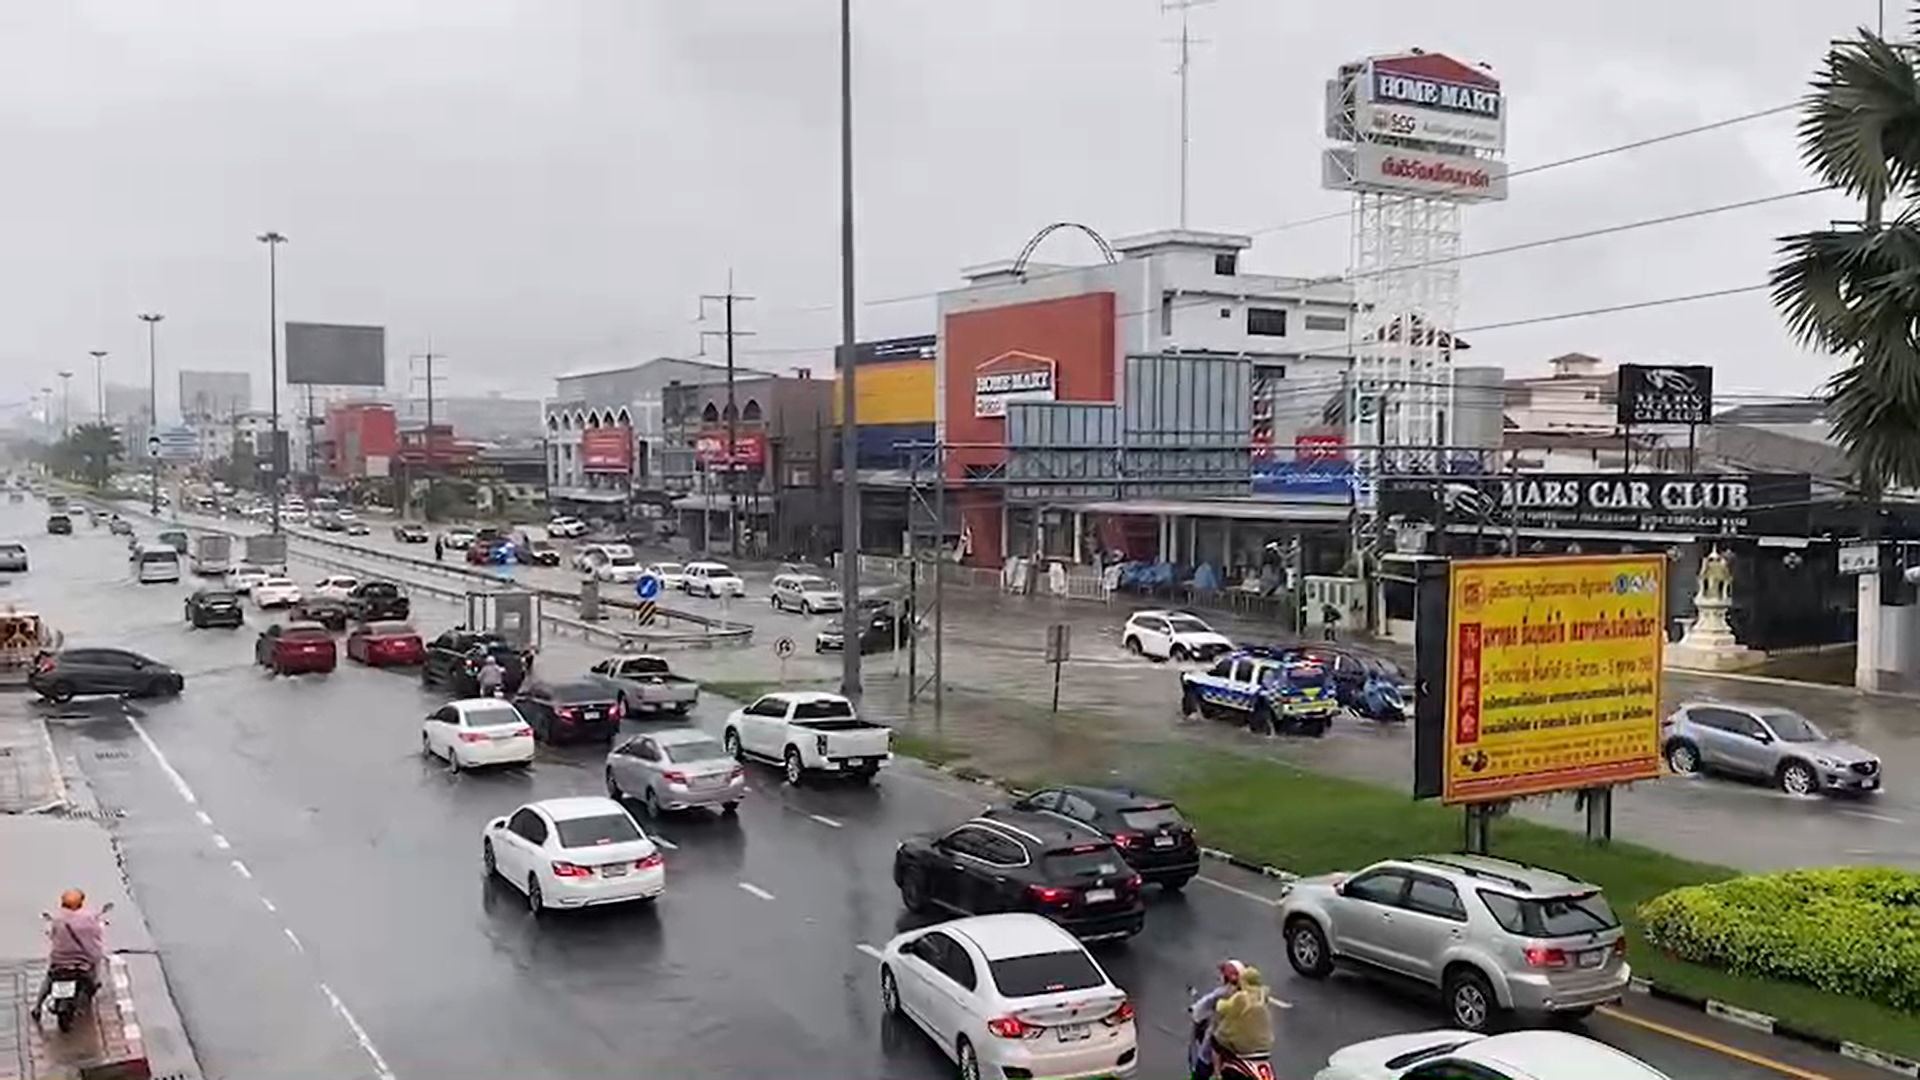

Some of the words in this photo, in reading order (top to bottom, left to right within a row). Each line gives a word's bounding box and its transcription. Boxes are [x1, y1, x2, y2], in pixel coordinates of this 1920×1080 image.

[1379, 77, 1439, 104] HOME
[1440, 84, 1498, 112] MART
[1391, 113, 1416, 132] SCG
[976, 375, 1011, 393] HOME
[1011, 371, 1049, 390] MART
[1634, 410, 1662, 421] CAR
[1666, 411, 1703, 422] CLUB
[1500, 480, 1580, 507] MARS
[1588, 481, 1652, 509] CAR
[1660, 482, 1749, 512] CLUB
